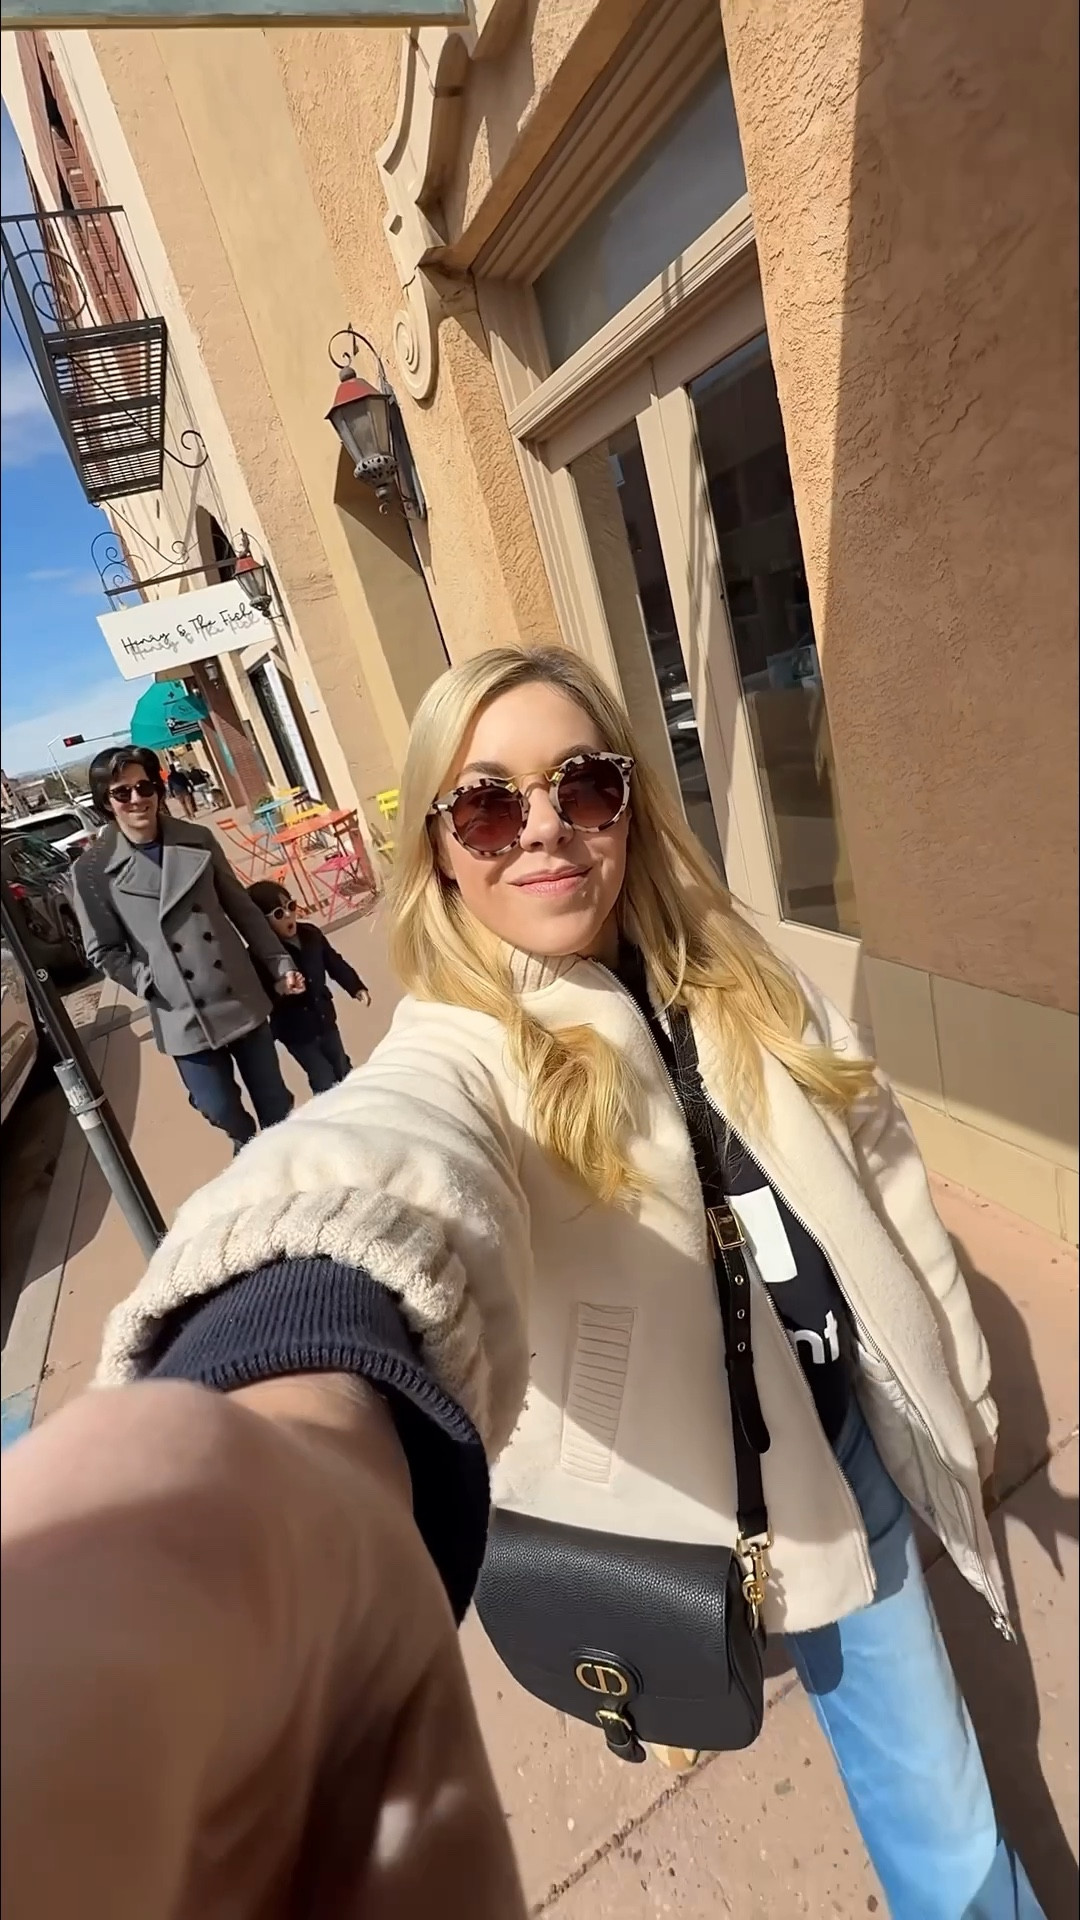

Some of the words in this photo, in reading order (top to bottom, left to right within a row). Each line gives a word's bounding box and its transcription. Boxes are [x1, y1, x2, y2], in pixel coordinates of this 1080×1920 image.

[121, 633, 170, 655] Henry
[176, 624, 187, 637] &
[188, 614, 216, 634] The
[219, 602, 252, 626] Fish
